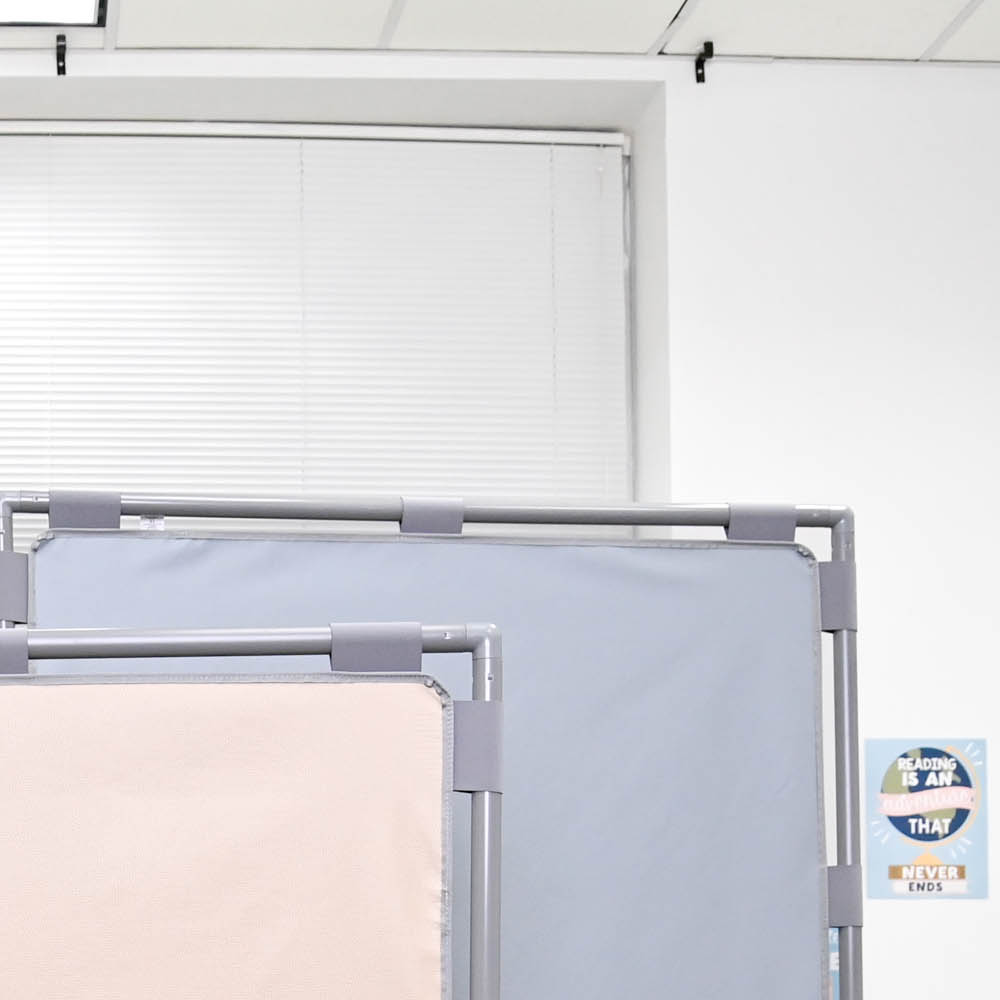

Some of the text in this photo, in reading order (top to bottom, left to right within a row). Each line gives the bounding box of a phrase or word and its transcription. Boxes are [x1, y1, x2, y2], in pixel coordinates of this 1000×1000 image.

[897, 757, 957, 771] READING
[902, 772, 953, 786] IS AN
[908, 818, 951, 834] THAT
[901, 865, 958, 880] NEVER
[908, 881, 943, 892] ENDS
